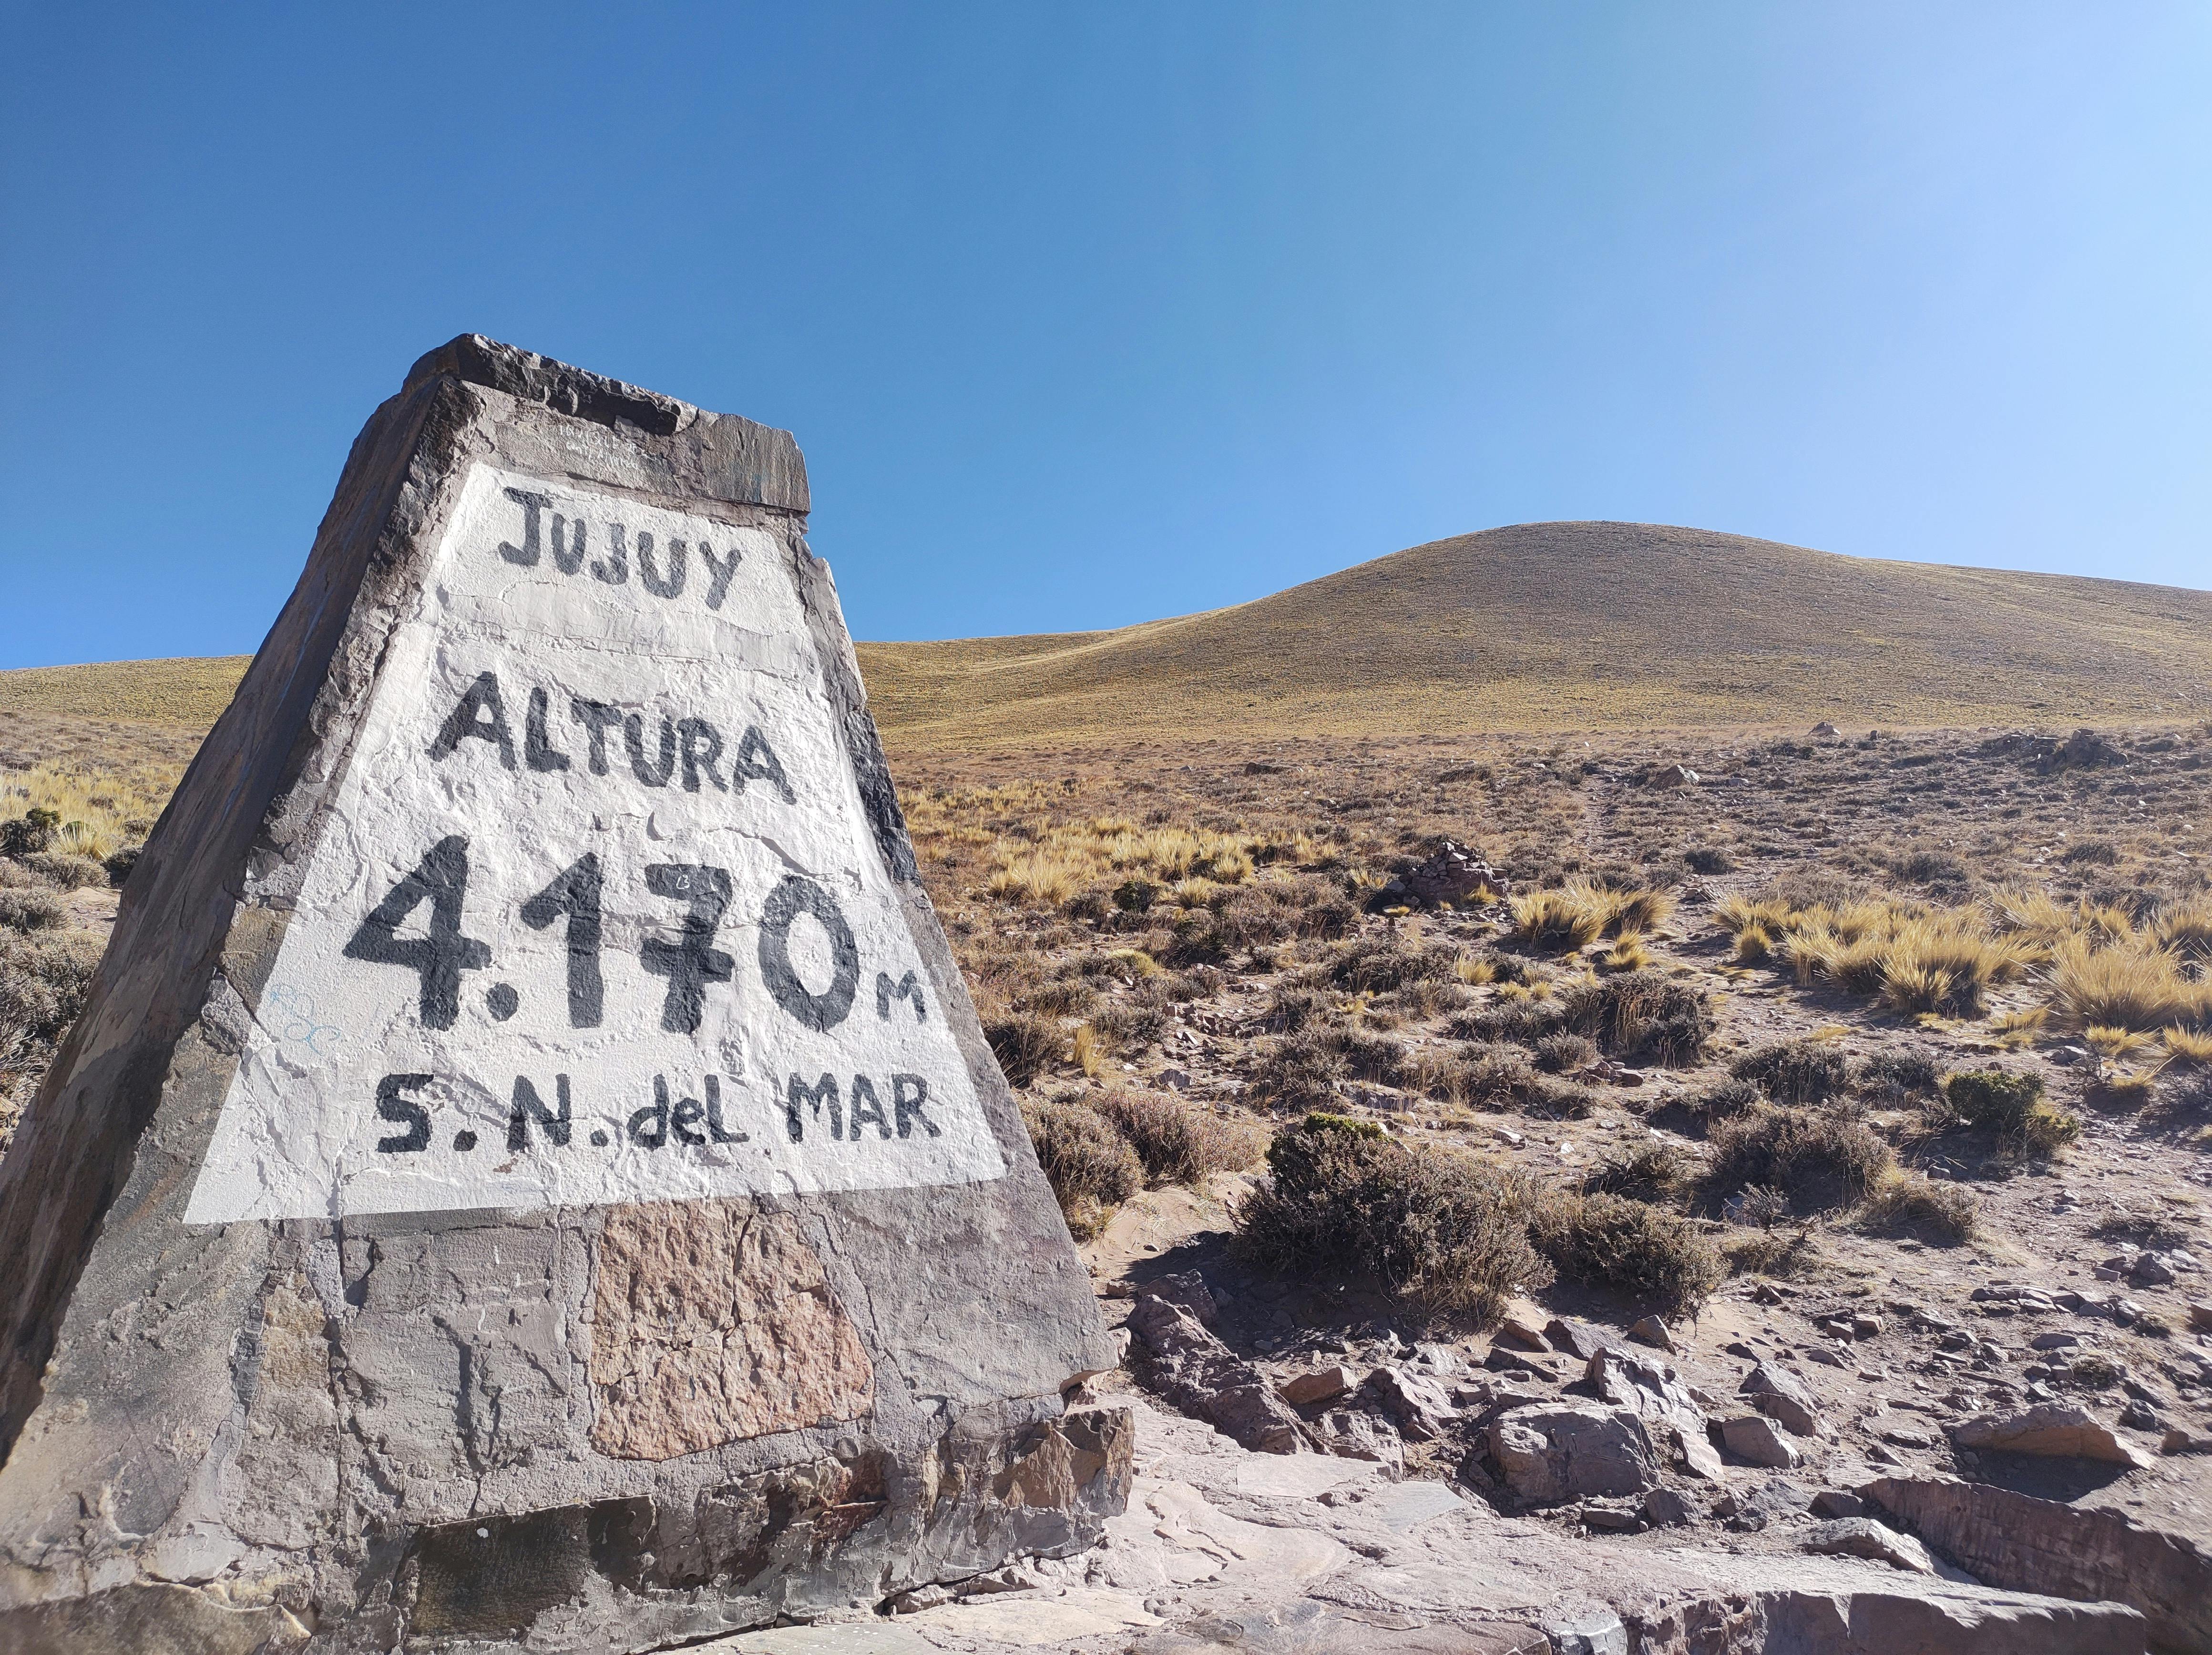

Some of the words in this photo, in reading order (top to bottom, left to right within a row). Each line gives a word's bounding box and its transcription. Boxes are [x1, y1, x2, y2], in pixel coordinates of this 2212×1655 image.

[497, 487, 742, 610] JUJUY
[425, 669, 797, 805] ALTURA
[344, 834, 860, 1032] 4.170
[787, 1072, 942, 1142] MAR
